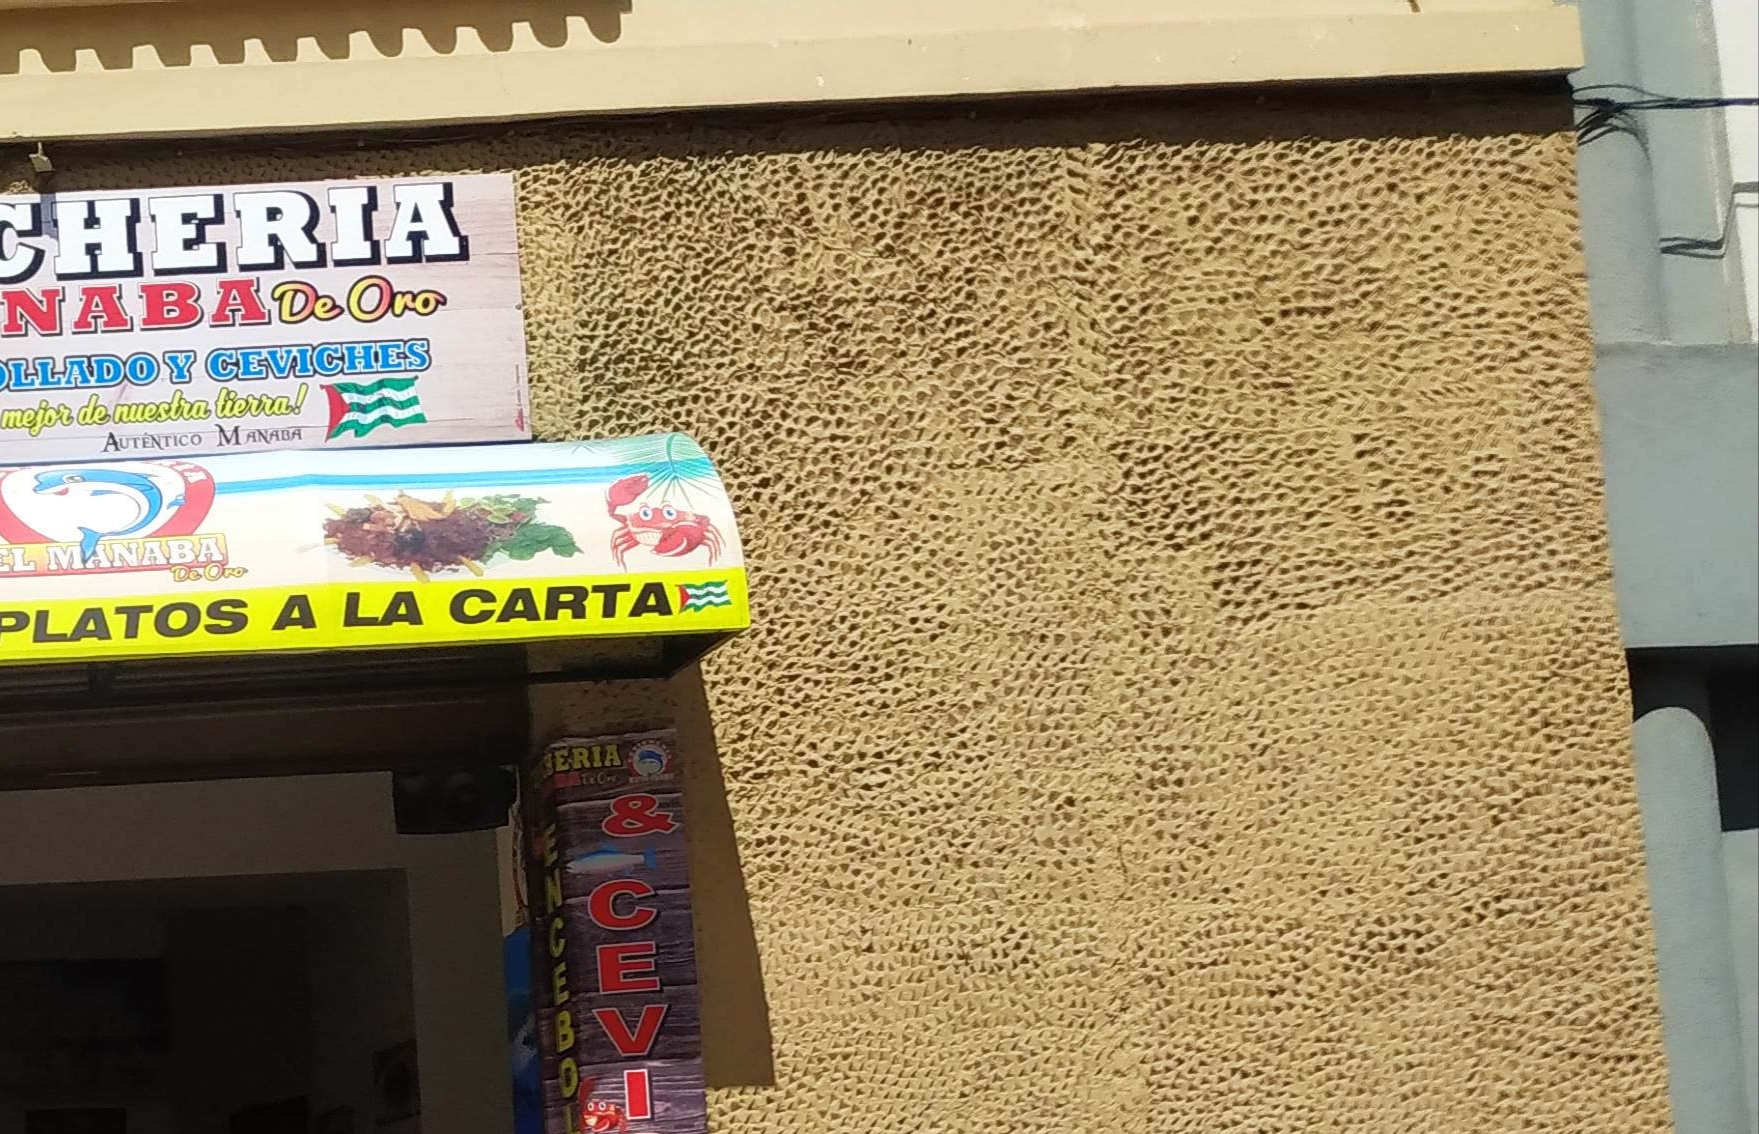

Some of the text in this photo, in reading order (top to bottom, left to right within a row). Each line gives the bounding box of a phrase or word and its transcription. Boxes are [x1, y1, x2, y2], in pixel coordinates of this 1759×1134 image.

[271, 279, 346, 324] De
[347, 275, 447, 323] Oro
[162, 350, 197, 384] Y
[206, 338, 431, 381] CEVICHES
[0, 400, 73, 437] mejor
[76, 393, 111, 426] de
[112, 389, 211, 424] nuestra
[214, 381, 310, 419] tierra!
[46, 537, 225, 569] MANABA
[169, 562, 248, 582] De Oro
[271, 594, 319, 632] A
[342, 589, 424, 628] LA
[448, 582, 674, 625] CARTA
[601, 793, 681, 838] &
